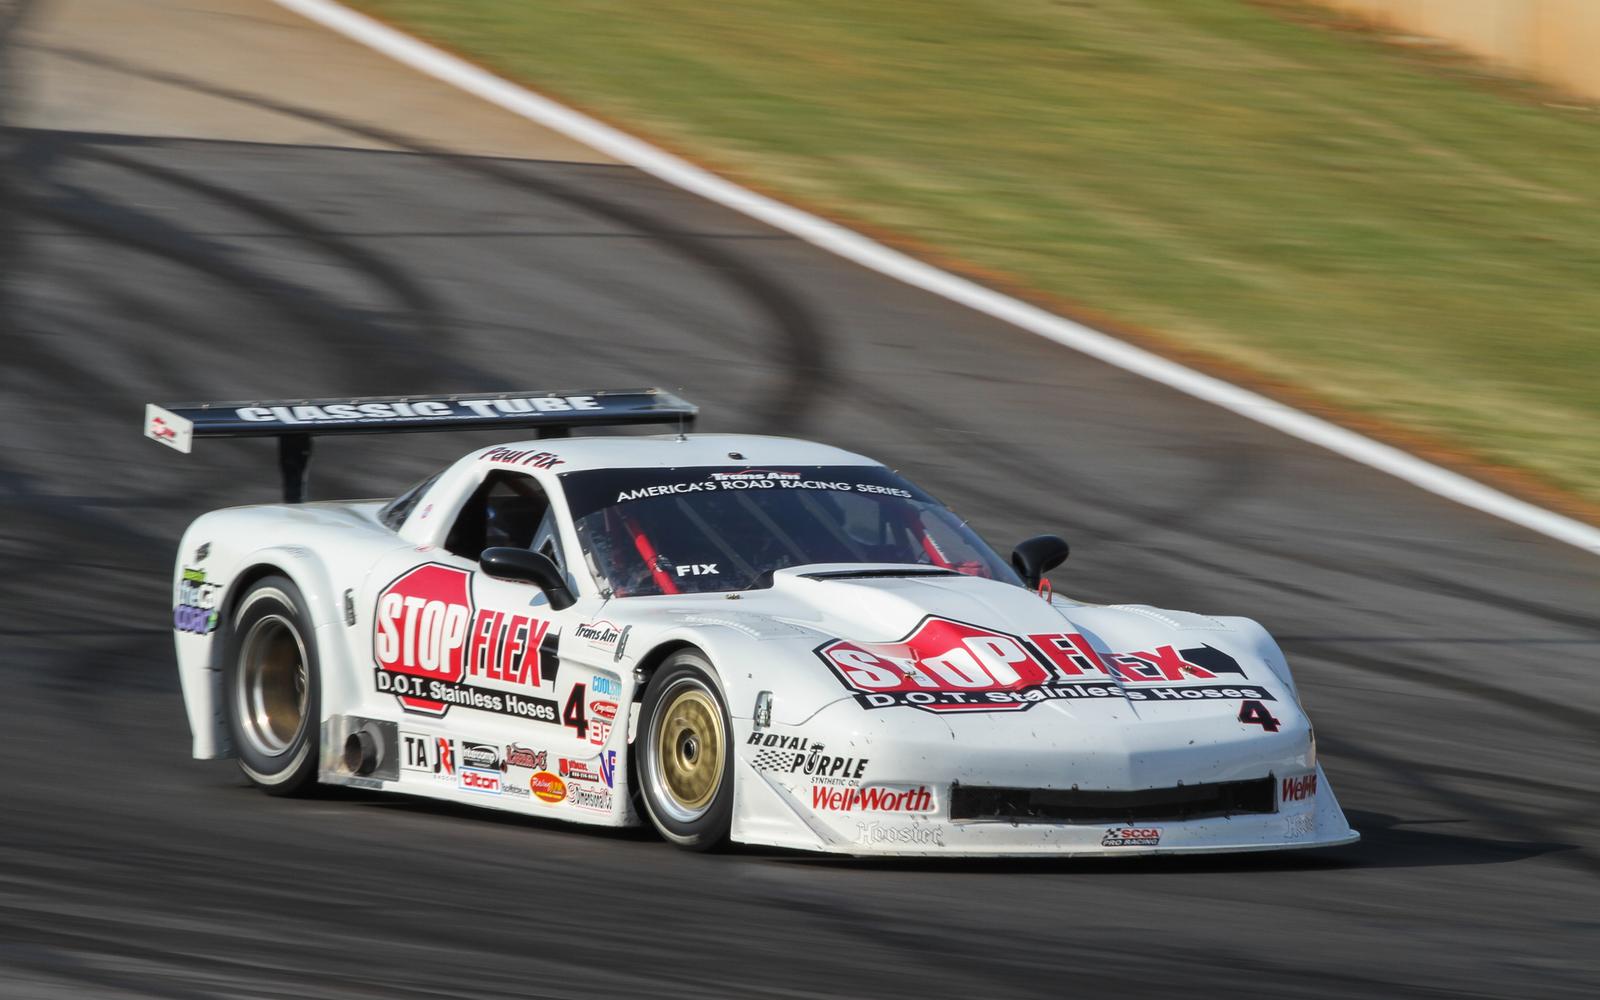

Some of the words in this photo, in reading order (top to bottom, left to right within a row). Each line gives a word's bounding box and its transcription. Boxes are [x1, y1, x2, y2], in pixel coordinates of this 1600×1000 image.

[235, 402, 454, 425] CLASSIC
[458, 396, 604, 418] TUBE
[479, 447, 535, 464] Paul
[522, 452, 566, 470] Fix
[709, 472, 763, 481] Trans
[766, 472, 801, 480] Am
[616, 481, 717, 503] AMERICA'S
[721, 480, 776, 490] ROAD
[779, 480, 852, 491] RACING
[856, 483, 912, 498] SERIES
[676, 563, 720, 577] FIX
[376, 592, 469, 674] STOP
[469, 608, 551, 688] FLEX
[575, 623, 602, 641] Trans
[600, 627, 618, 643] Am
[829, 635, 1028, 688] STOP
[377, 671, 428, 697] D.O.T.
[429, 681, 503, 711] Stainless
[504, 694, 556, 721] Hoses
[870, 691, 979, 708] D.O.T.
[984, 684, 1148, 704] Stainless
[1151, 687, 1264, 700] Hoses
[563, 682, 590, 740] 4
[1238, 700, 1282, 733] 4
[404, 736, 429, 768] TA
[746, 731, 809, 751] ROYAL
[789, 752, 870, 779] PURPLE
[810, 776, 846, 787] SYNTHETIC
[847, 779, 860, 788] OIL
[856, 820, 945, 847] Hoosier
[1102, 839, 1123, 847] PRO
[1123, 838, 1158, 846] RACING
[1121, 829, 1160, 838] SCCA
